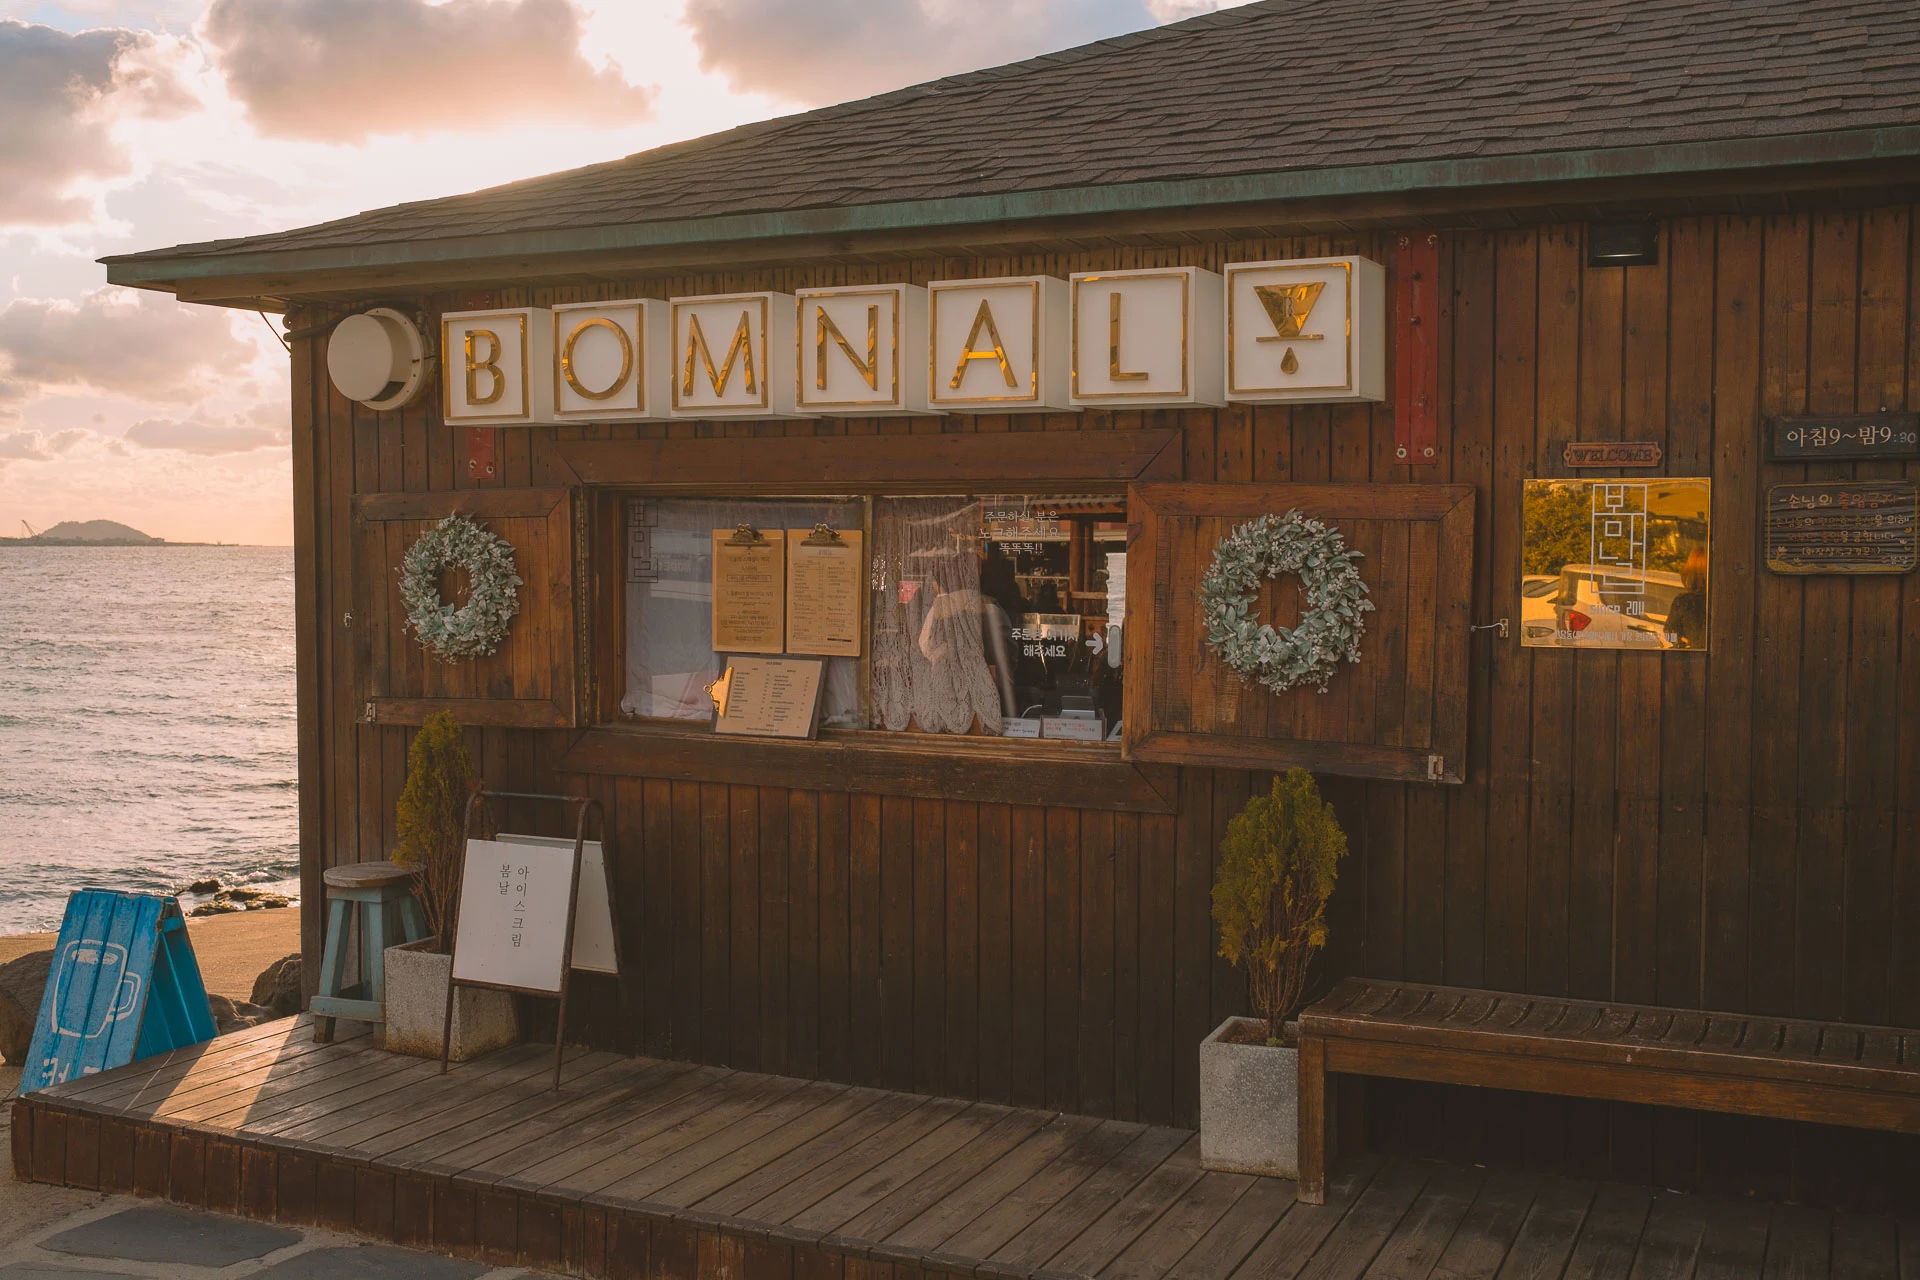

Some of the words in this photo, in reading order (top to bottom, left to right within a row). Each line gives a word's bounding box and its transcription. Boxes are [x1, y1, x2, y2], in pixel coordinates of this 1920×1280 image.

[465, 292, 1148, 405] BOMNAL
[1572, 449, 1652, 462] WELCOME
[1035, 510, 1060, 523] 분은
[1588, 602, 1621, 616] since
[511, 865, 530, 948] 아이스크림
